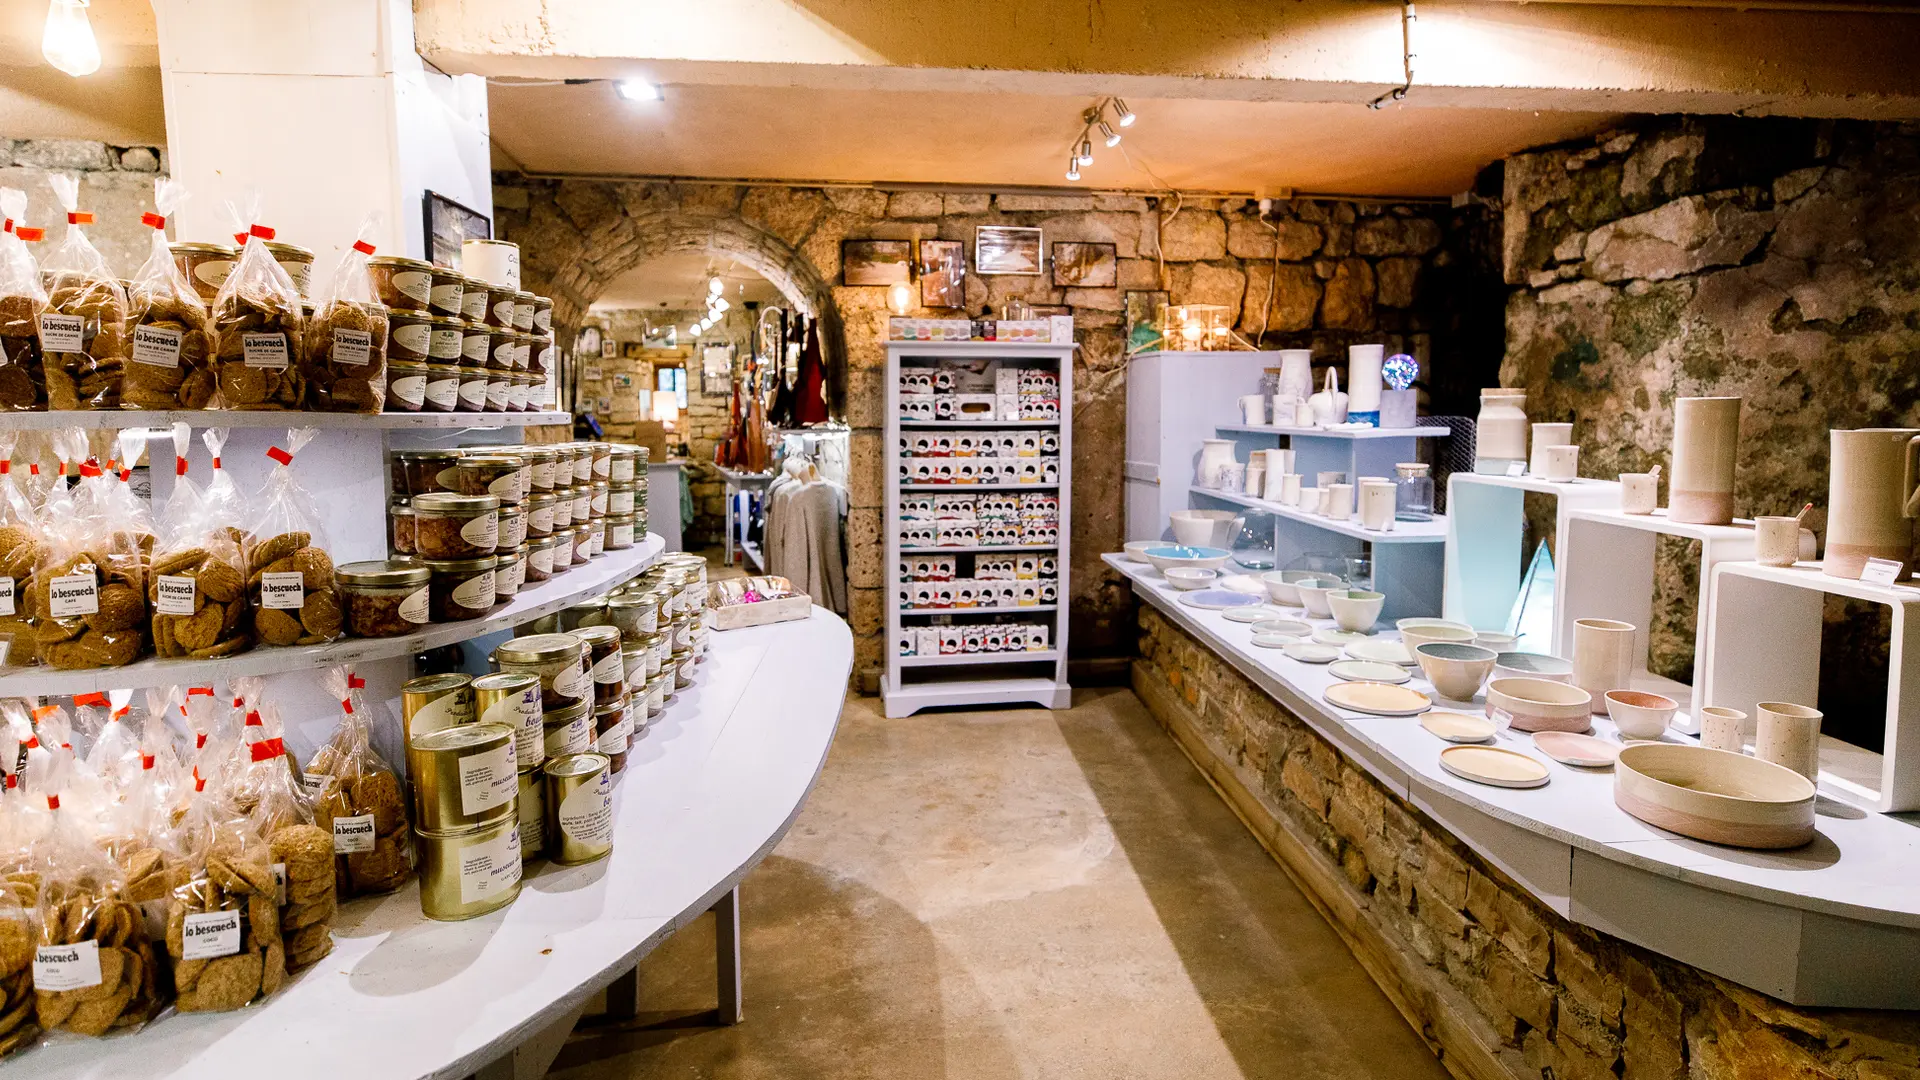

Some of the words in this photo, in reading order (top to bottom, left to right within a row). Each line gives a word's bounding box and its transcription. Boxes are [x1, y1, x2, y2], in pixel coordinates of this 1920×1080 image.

[42, 320, 49, 330] lo
[49, 320, 81, 332] bescuech
[135, 331, 143, 341] lo
[143, 332, 178, 347] bescuech
[245, 339, 252, 347] lo
[252, 338, 284, 347] bescuech
[336, 334, 342, 342] lo
[342, 334, 370, 346] bescuech
[51, 588, 58, 599] lo
[58, 585, 95, 598] bescuech
[159, 582, 165, 592] lo
[164, 583, 193, 594] bescuech
[262, 582, 269, 593] lo
[268, 582, 302, 593] bescuech
[334, 825, 341, 835] lo
[341, 823, 373, 835] bescuech
[185, 926, 194, 937] lo
[195, 919, 237, 936] bescuech
[38, 950, 80, 963] bescuech
